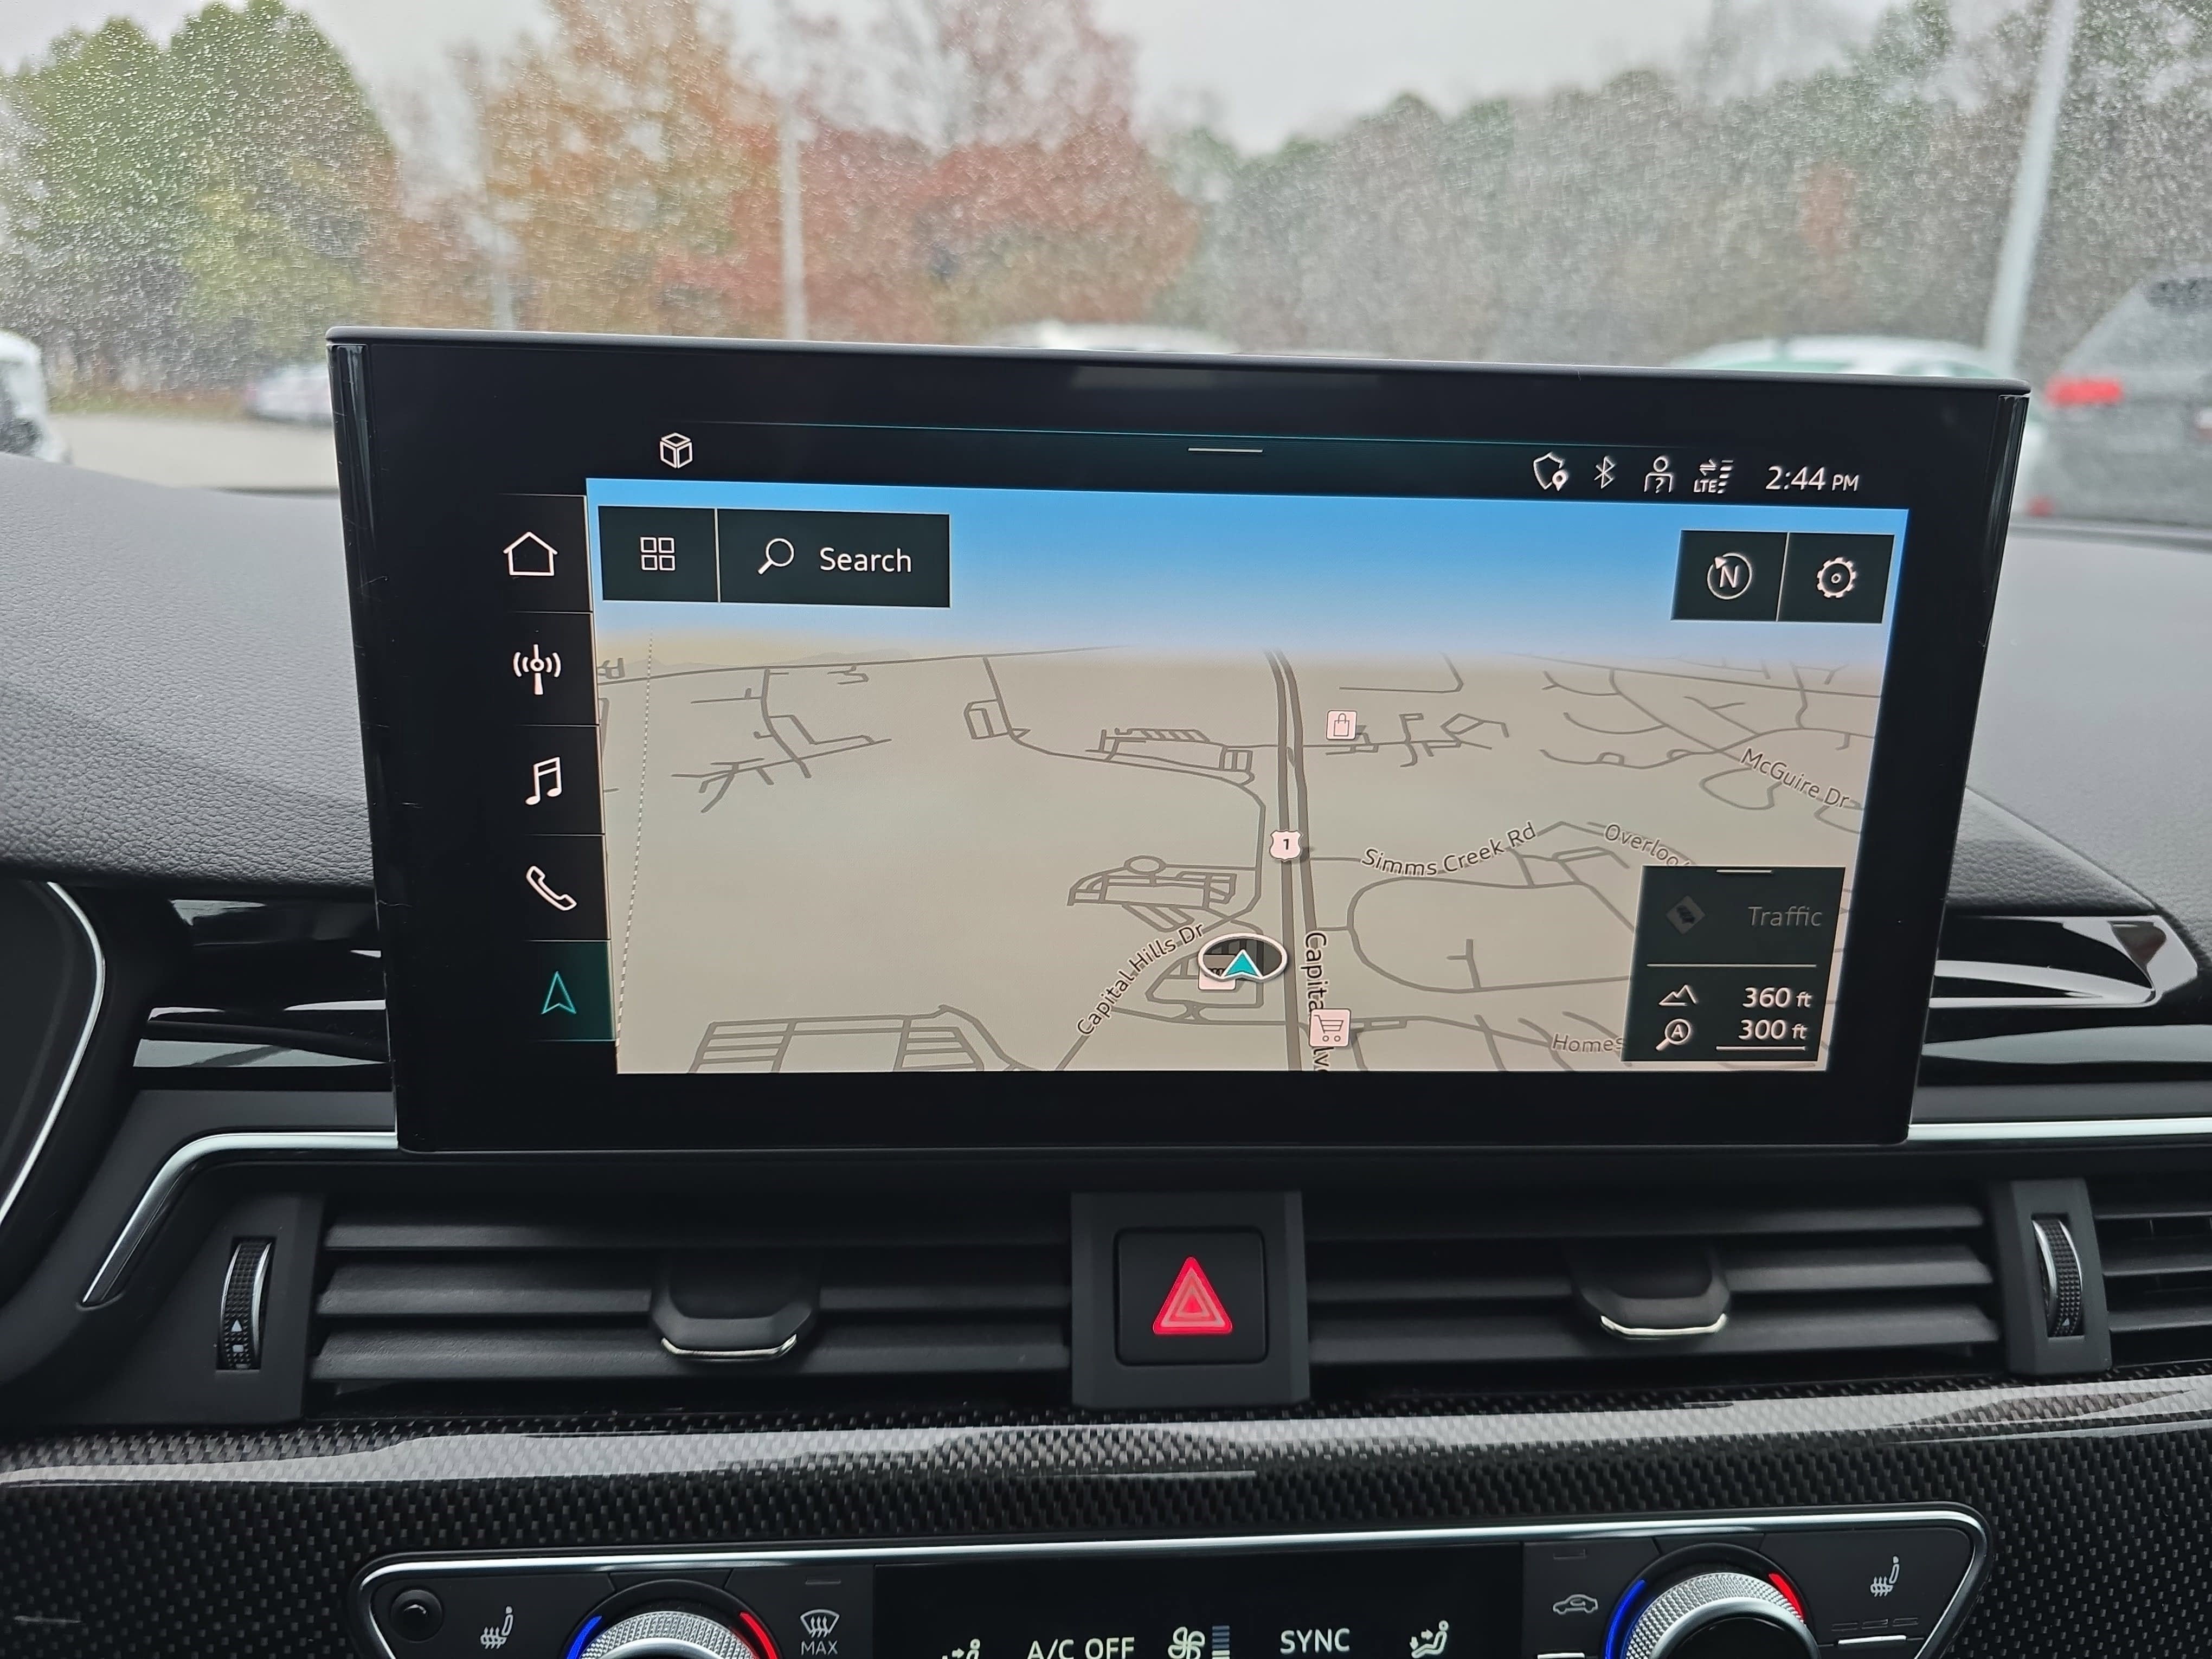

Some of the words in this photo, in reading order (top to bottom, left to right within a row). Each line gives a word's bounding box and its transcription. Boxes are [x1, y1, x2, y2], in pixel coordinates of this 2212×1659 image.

[1693, 479, 1718, 493] LTE
[1765, 466, 1826, 490] 2:44
[1831, 474, 1860, 491] PM
[819, 546, 912, 573] Search
[1719, 564, 1740, 588] N
[1740, 748, 1820, 798] McGuire
[1823, 787, 1849, 808] Dr
[1283, 838, 1289, 850] 1
[1361, 848, 1437, 876] Simms
[1443, 839, 1505, 872] Creek
[1507, 821, 1536, 847] Rd
[1605, 824, 1690, 865] Overloo
[1747, 906, 1822, 926] Traffic
[1077, 970, 1135, 1035] Capital
[1129, 939, 1176, 972] Hills
[1178, 923, 1204, 944] Dr
[1301, 932, 1327, 1012] Capita
[1742, 987, 1791, 1008] 360
[1796, 991, 1813, 1008] ft
[1670, 1024, 1683, 1038] A
[1738, 1019, 1787, 1040] 300
[1791, 1023, 1809, 1040] ft
[801, 1640, 838, 1655] MAX
[1026, 1638, 1075, 1659] A/C
[1084, 1637, 1135, 1659] OFF
[1279, 1628, 1351, 1654] SYNC
